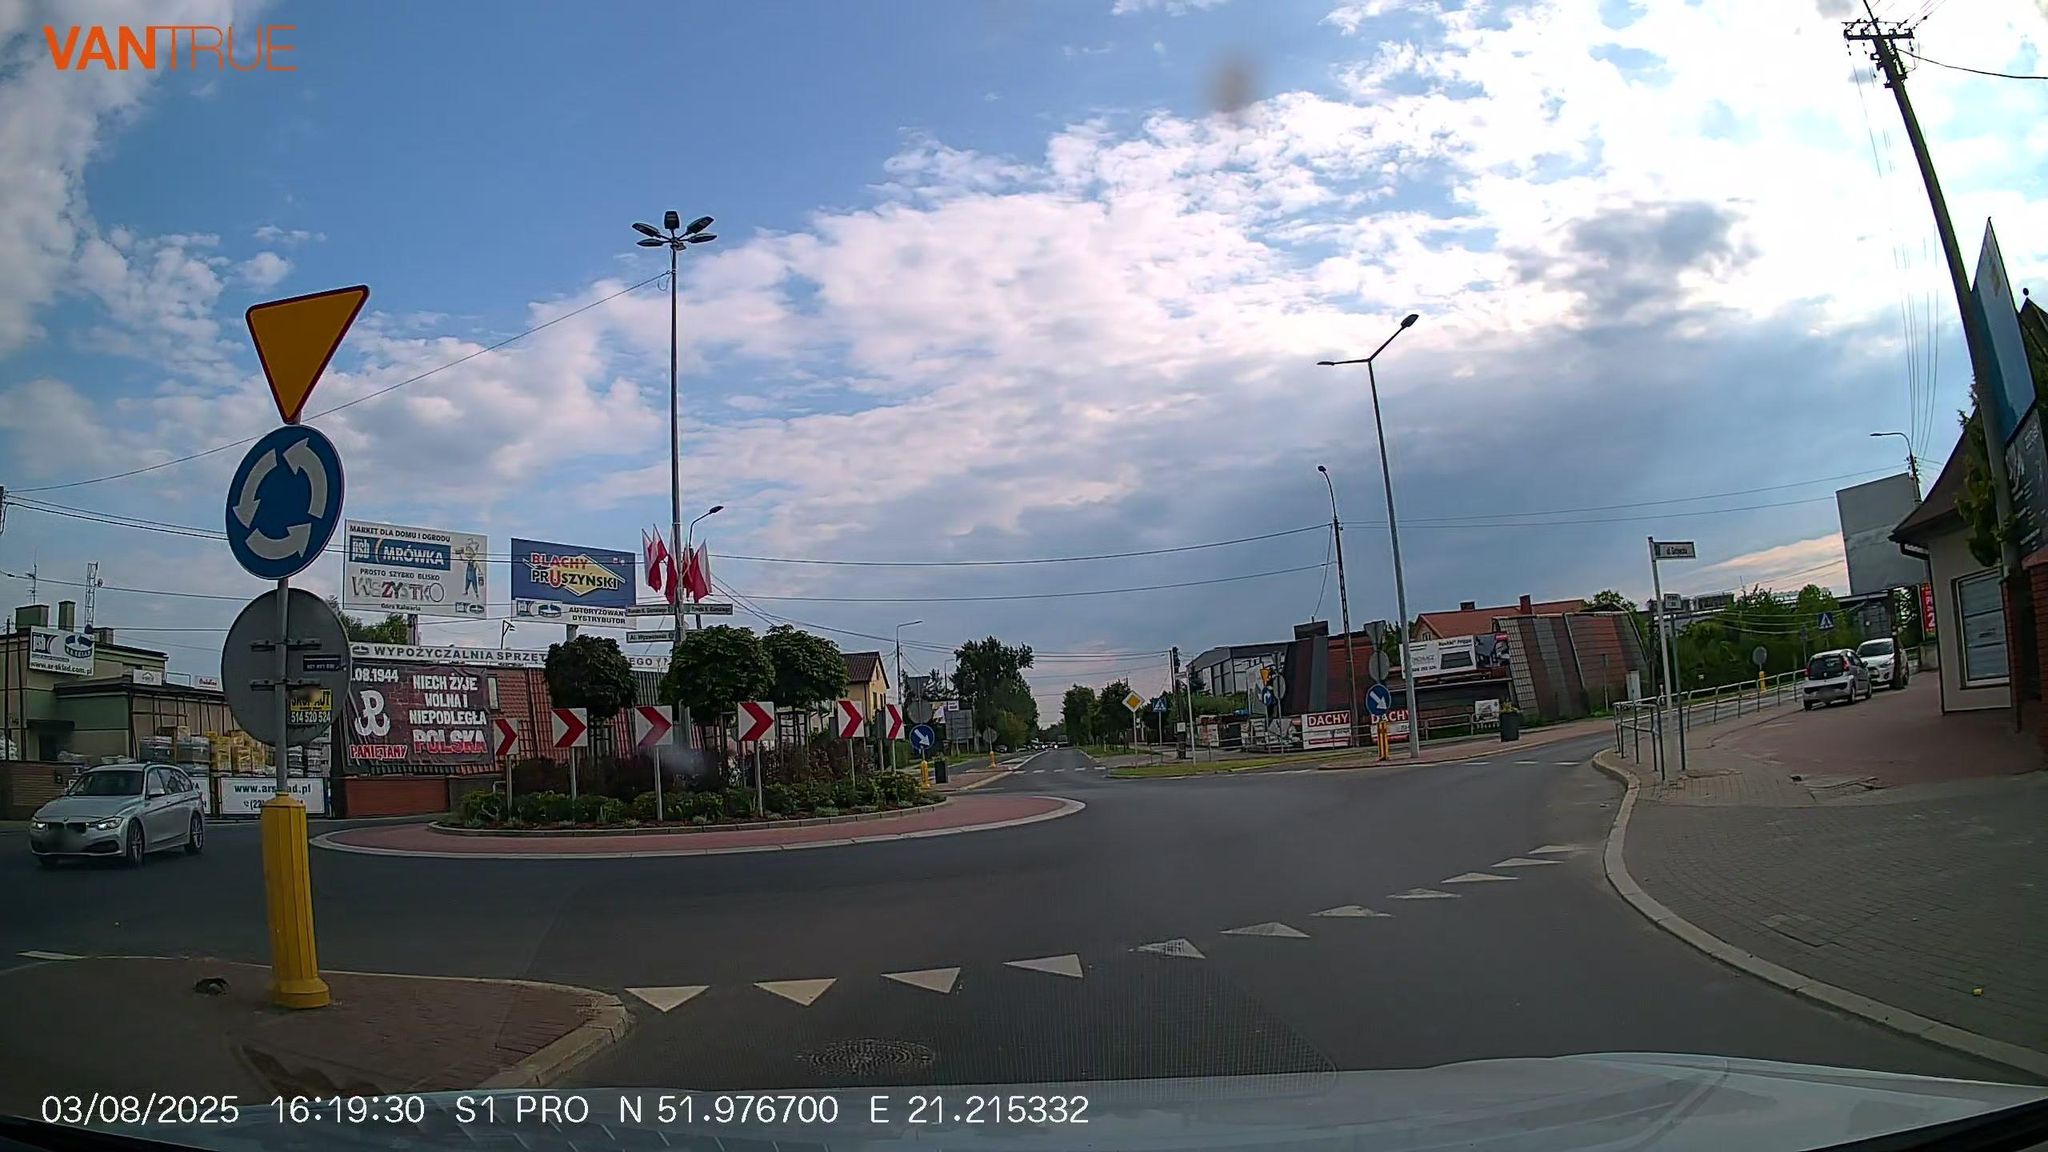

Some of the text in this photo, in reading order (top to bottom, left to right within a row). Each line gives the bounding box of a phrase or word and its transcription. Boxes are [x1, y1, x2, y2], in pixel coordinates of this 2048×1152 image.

[349, 525, 379, 535] MARKET
[380, 529, 394, 537] DLA
[395, 531, 417, 539] DOMU
[421, 534, 451, 542] OGRODU
[382, 544, 445, 566] MRÓWKA
[531, 553, 588, 571] BLACHY
[360, 568, 386, 576] PROSTO
[389, 571, 415, 579] SZYBKO
[531, 568, 619, 590] PRUSZYŃSKI
[569, 606, 625, 616] AUTORYZOWAN
[572, 614, 626, 624] DYSTRYBUTOR
[374, 645, 494, 660] WYPOŻYCZALNIA
[497, 651, 547, 663] SPRZĘT
[413, 673, 478, 691] NIECH ŻYJE
[425, 694, 463, 708] WOLNA
[291, 711, 331, 723] 514 520 524
[409, 709, 487, 724] NIEPODLEGŁA
[1308, 712, 1348, 726] DACHY
[413, 729, 488, 754] POLSKA
[350, 744, 408, 760] PAMIĘTAMY
